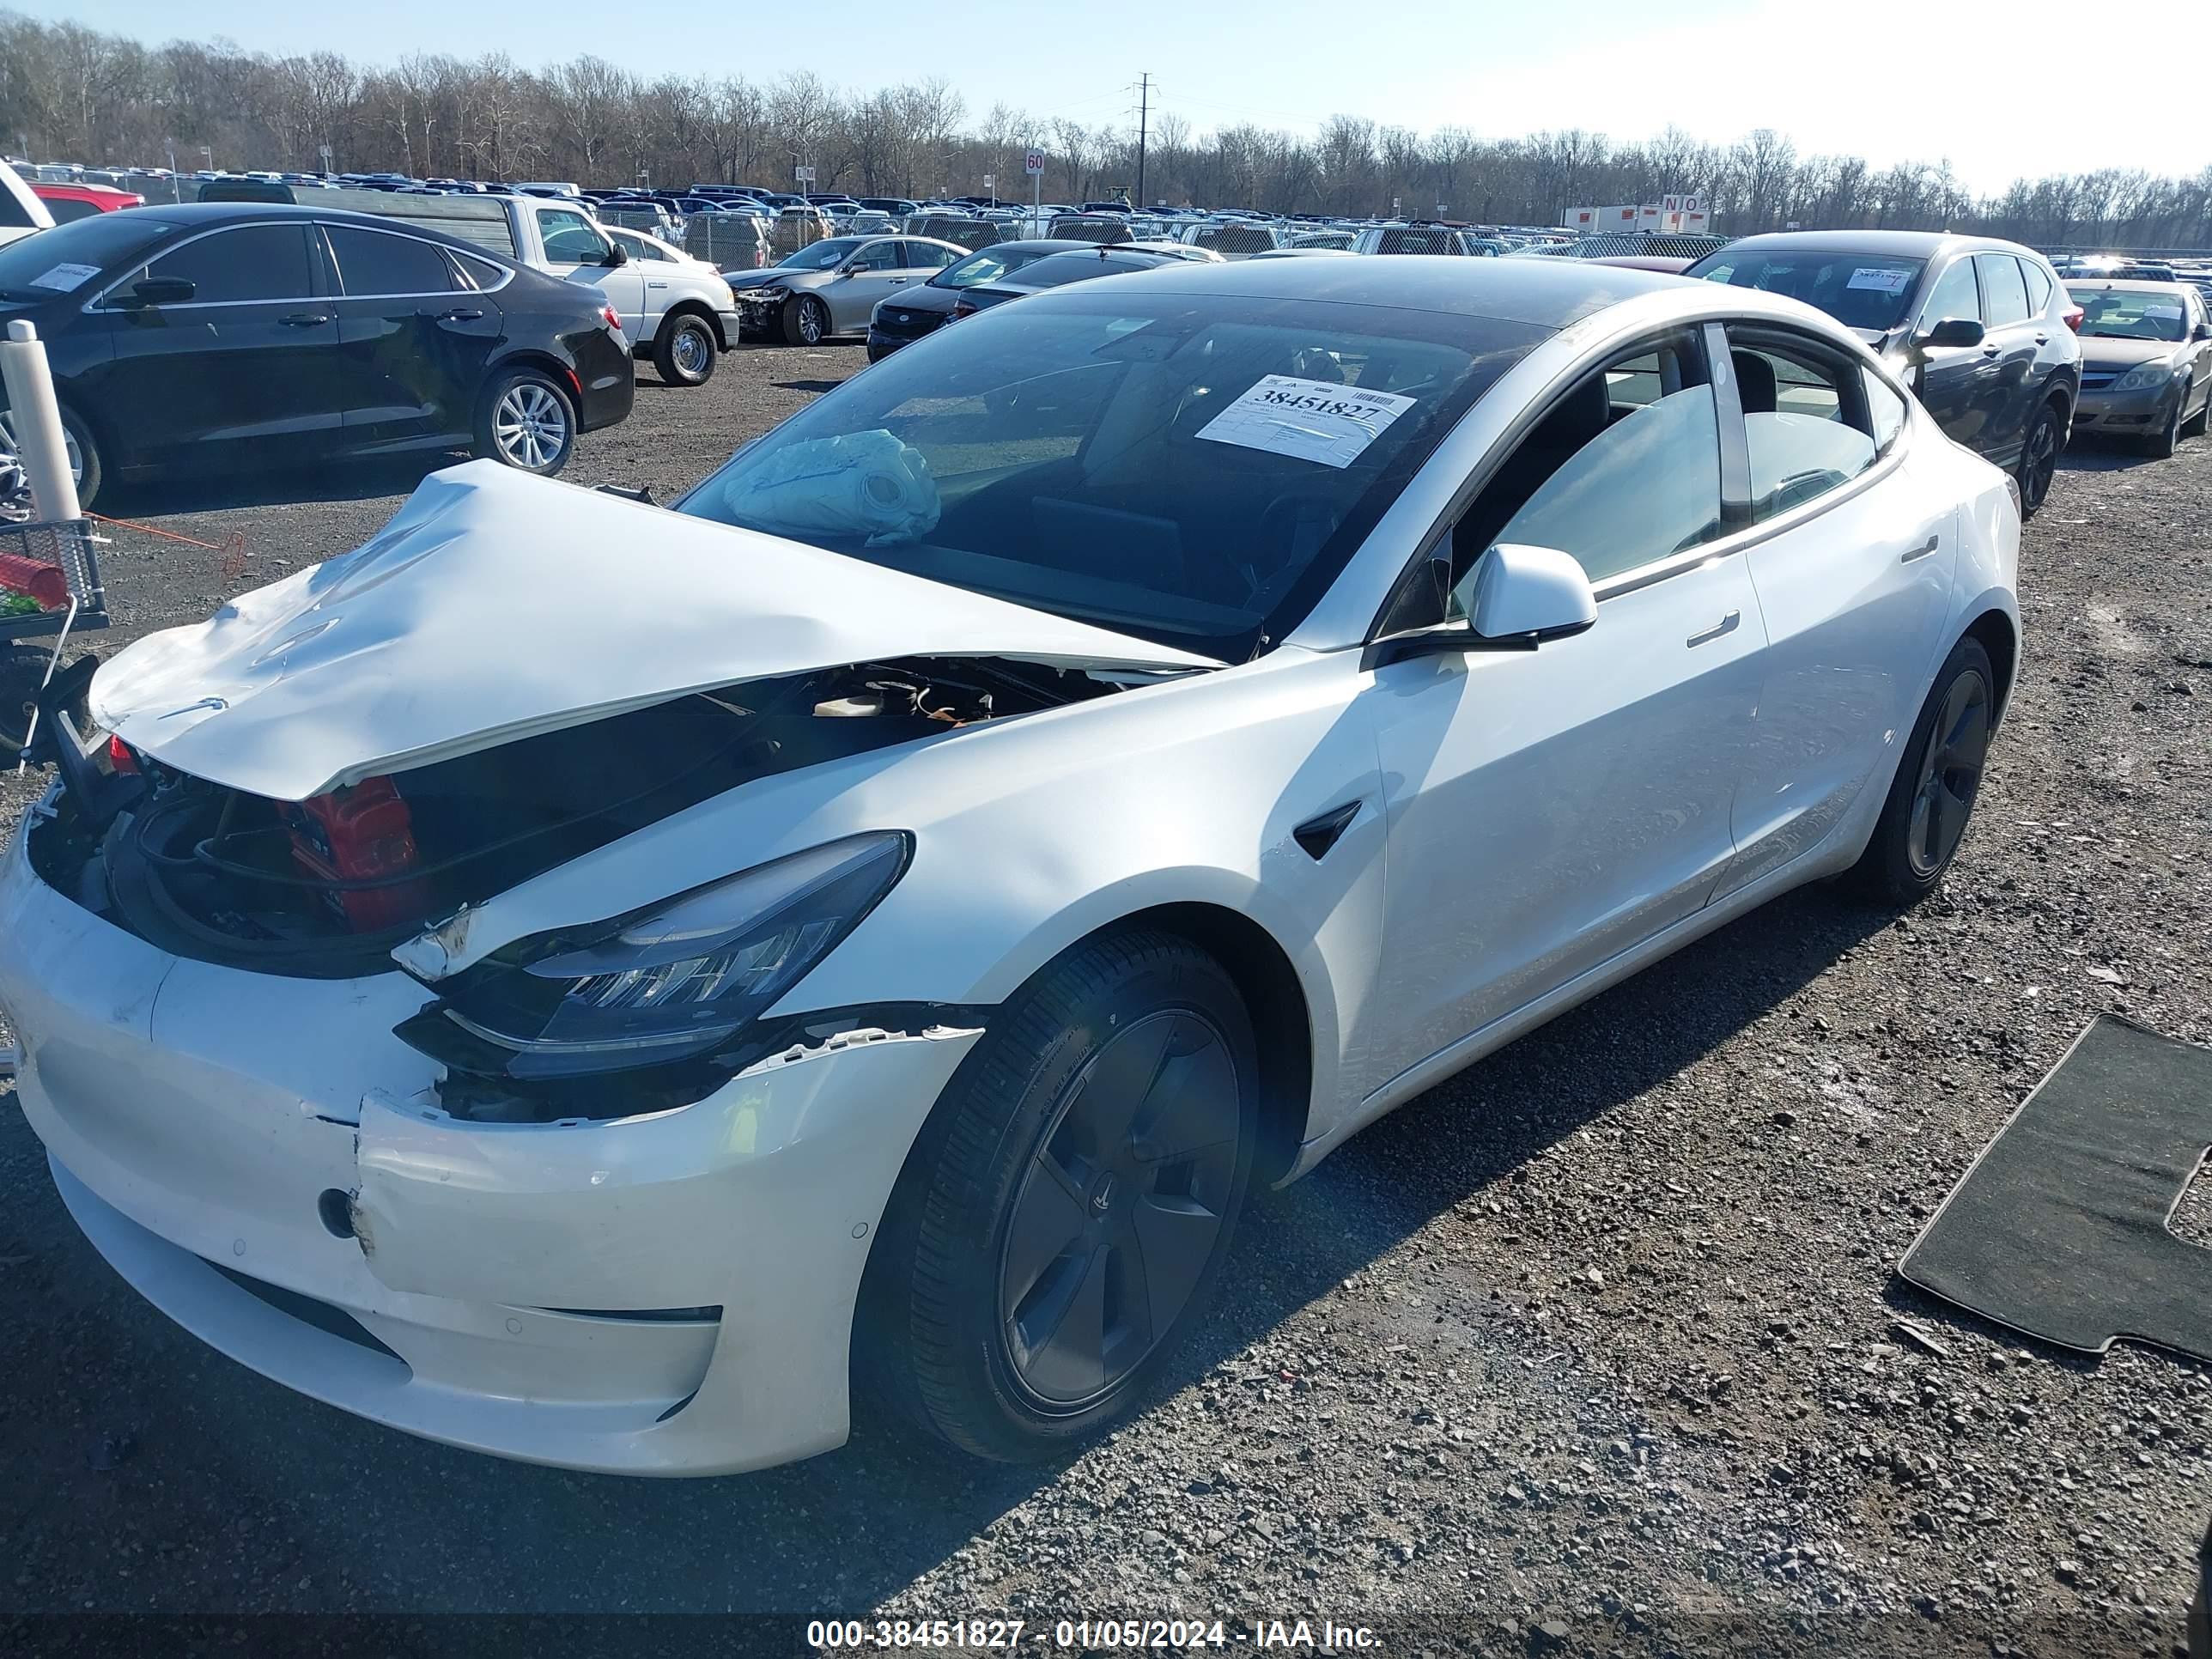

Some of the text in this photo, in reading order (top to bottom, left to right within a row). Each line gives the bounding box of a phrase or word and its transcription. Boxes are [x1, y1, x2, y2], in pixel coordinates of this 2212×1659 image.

[1028, 155, 1042, 169] 60
[1665, 198, 1675, 210] N
[1255, 390, 1382, 420] 38451827
